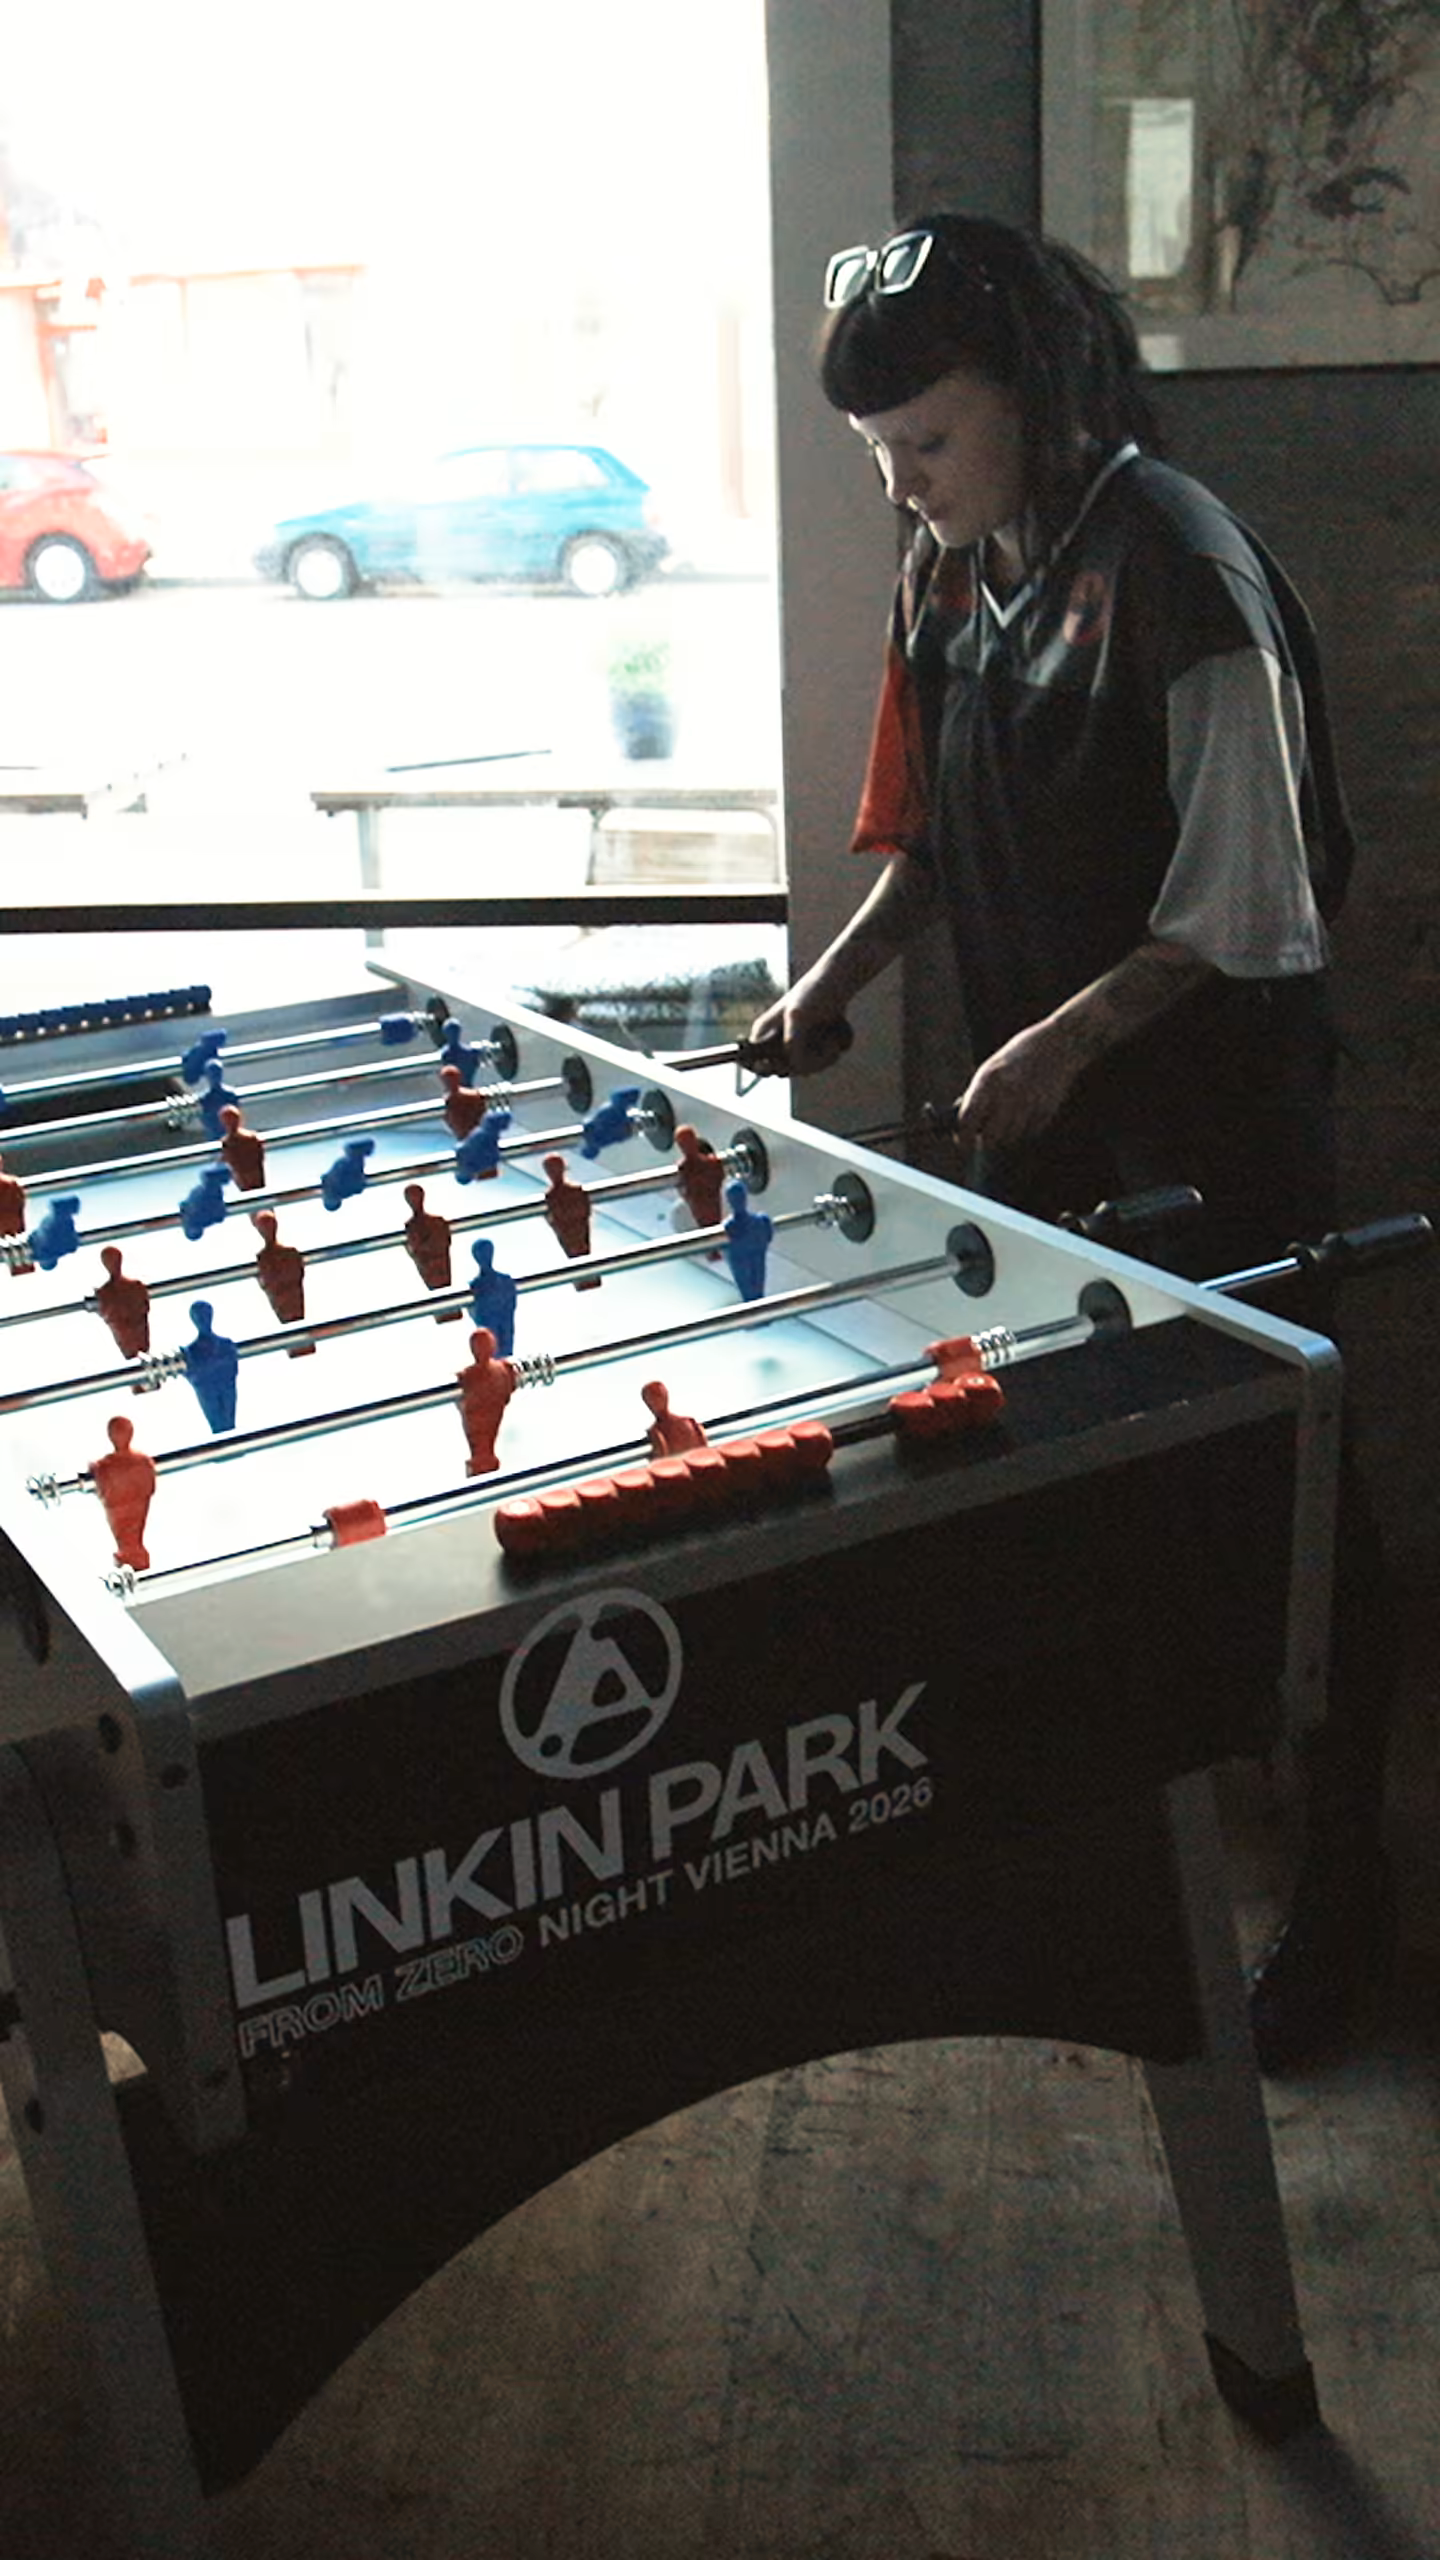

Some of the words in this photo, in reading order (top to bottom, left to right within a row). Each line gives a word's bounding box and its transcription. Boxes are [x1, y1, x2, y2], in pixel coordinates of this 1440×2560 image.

[225, 1787, 625, 2009] LINKIN
[648, 1681, 928, 1863] PARK
[237, 1972, 385, 2059] FROM
[393, 1925, 526, 2002] ZERO
[538, 1869, 674, 1948] NIGHT
[683, 1821, 837, 1890] VIENNA
[847, 1776, 934, 1834] 2026
